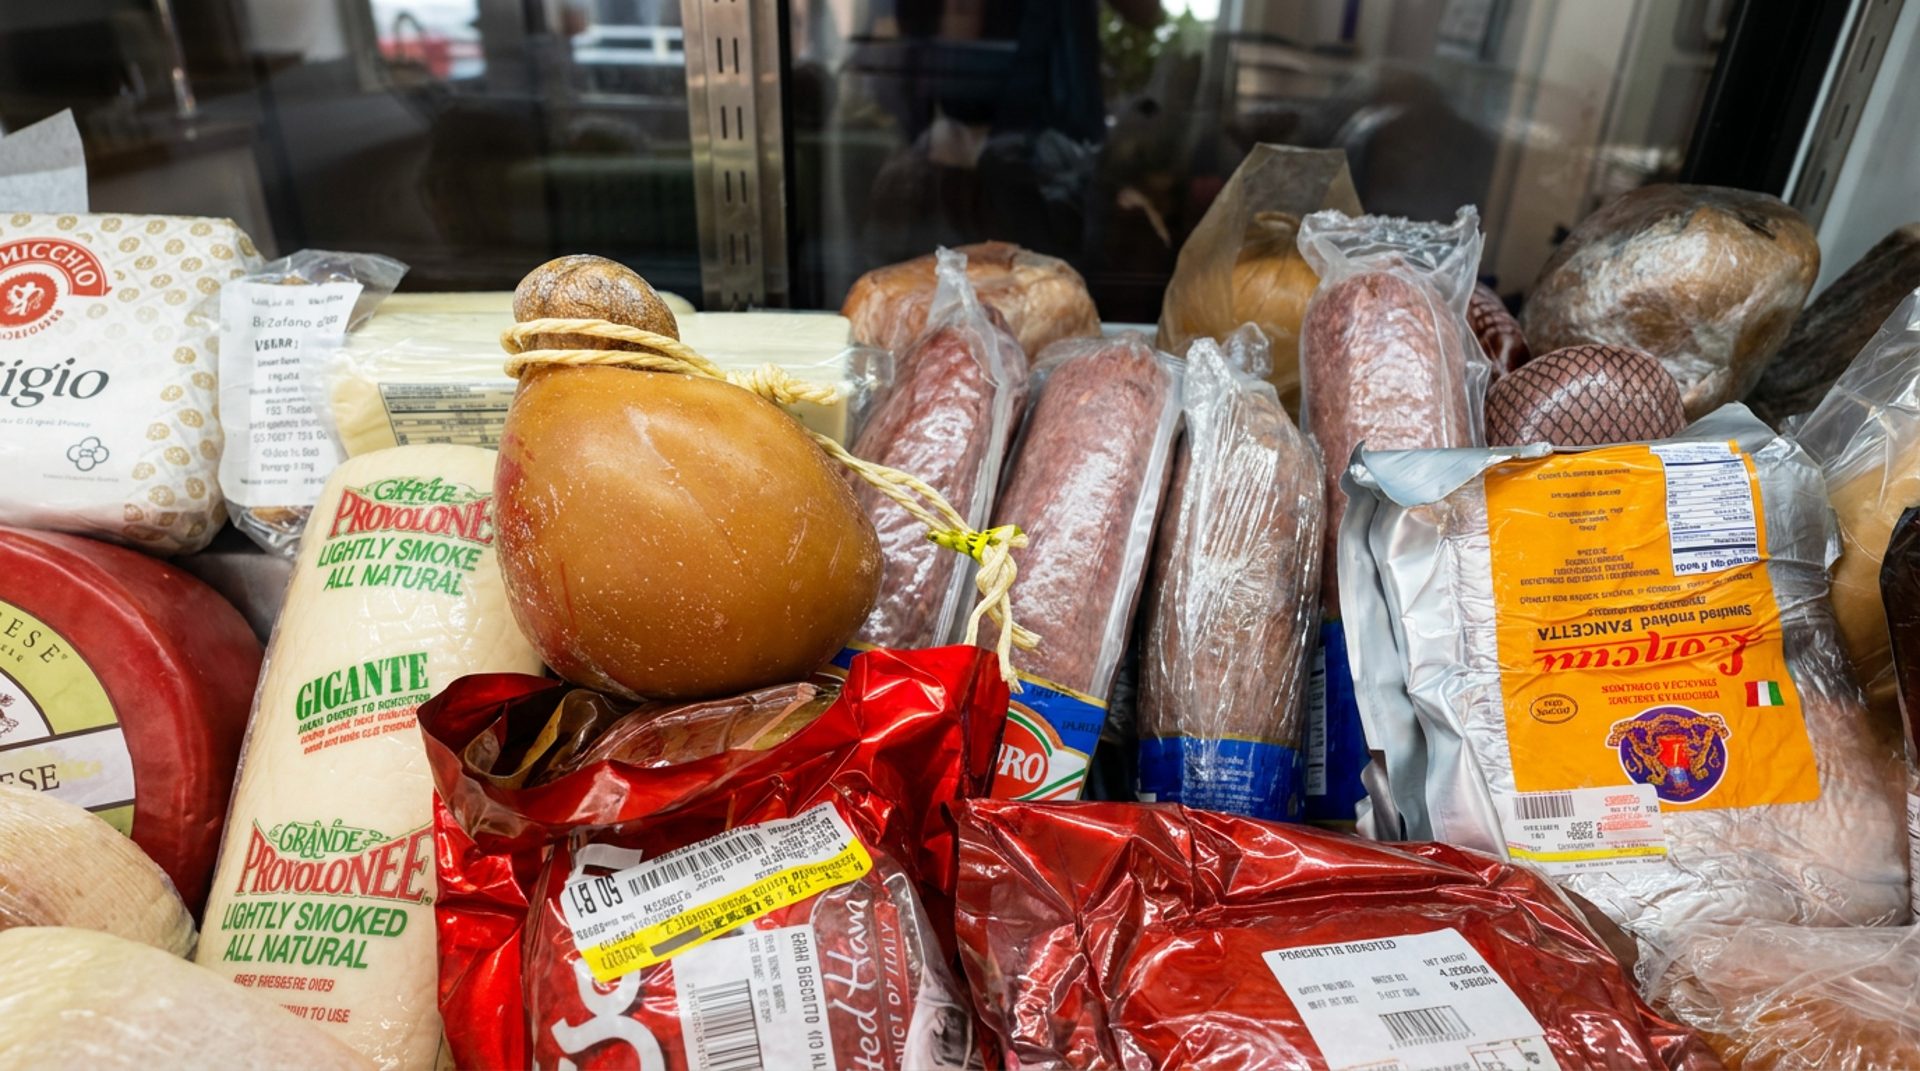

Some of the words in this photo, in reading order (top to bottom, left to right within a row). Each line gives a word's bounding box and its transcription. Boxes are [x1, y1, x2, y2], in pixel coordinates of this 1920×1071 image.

[0, 357, 110, 408] igio
[317, 537, 395, 568] LIGHTLY
[395, 538, 482, 572] SMOKE
[323, 565, 355, 591] ALL
[0, 611, 60, 663] ESE
[296, 652, 429, 721] GIGANTE
[0, 764, 60, 792] SE
[221, 902, 295, 931] LIGHTLY
[294, 902, 408, 938] SMOKED
[223, 934, 256, 962] ALL
[258, 935, 368, 970] NATURAL
[823, 899, 877, 998] Ham
[880, 921, 900, 976] ITALY
[310, 1007, 326, 1021] TO
[327, 1008, 350, 1023] USE
[833, 998, 885, 1071] ted
